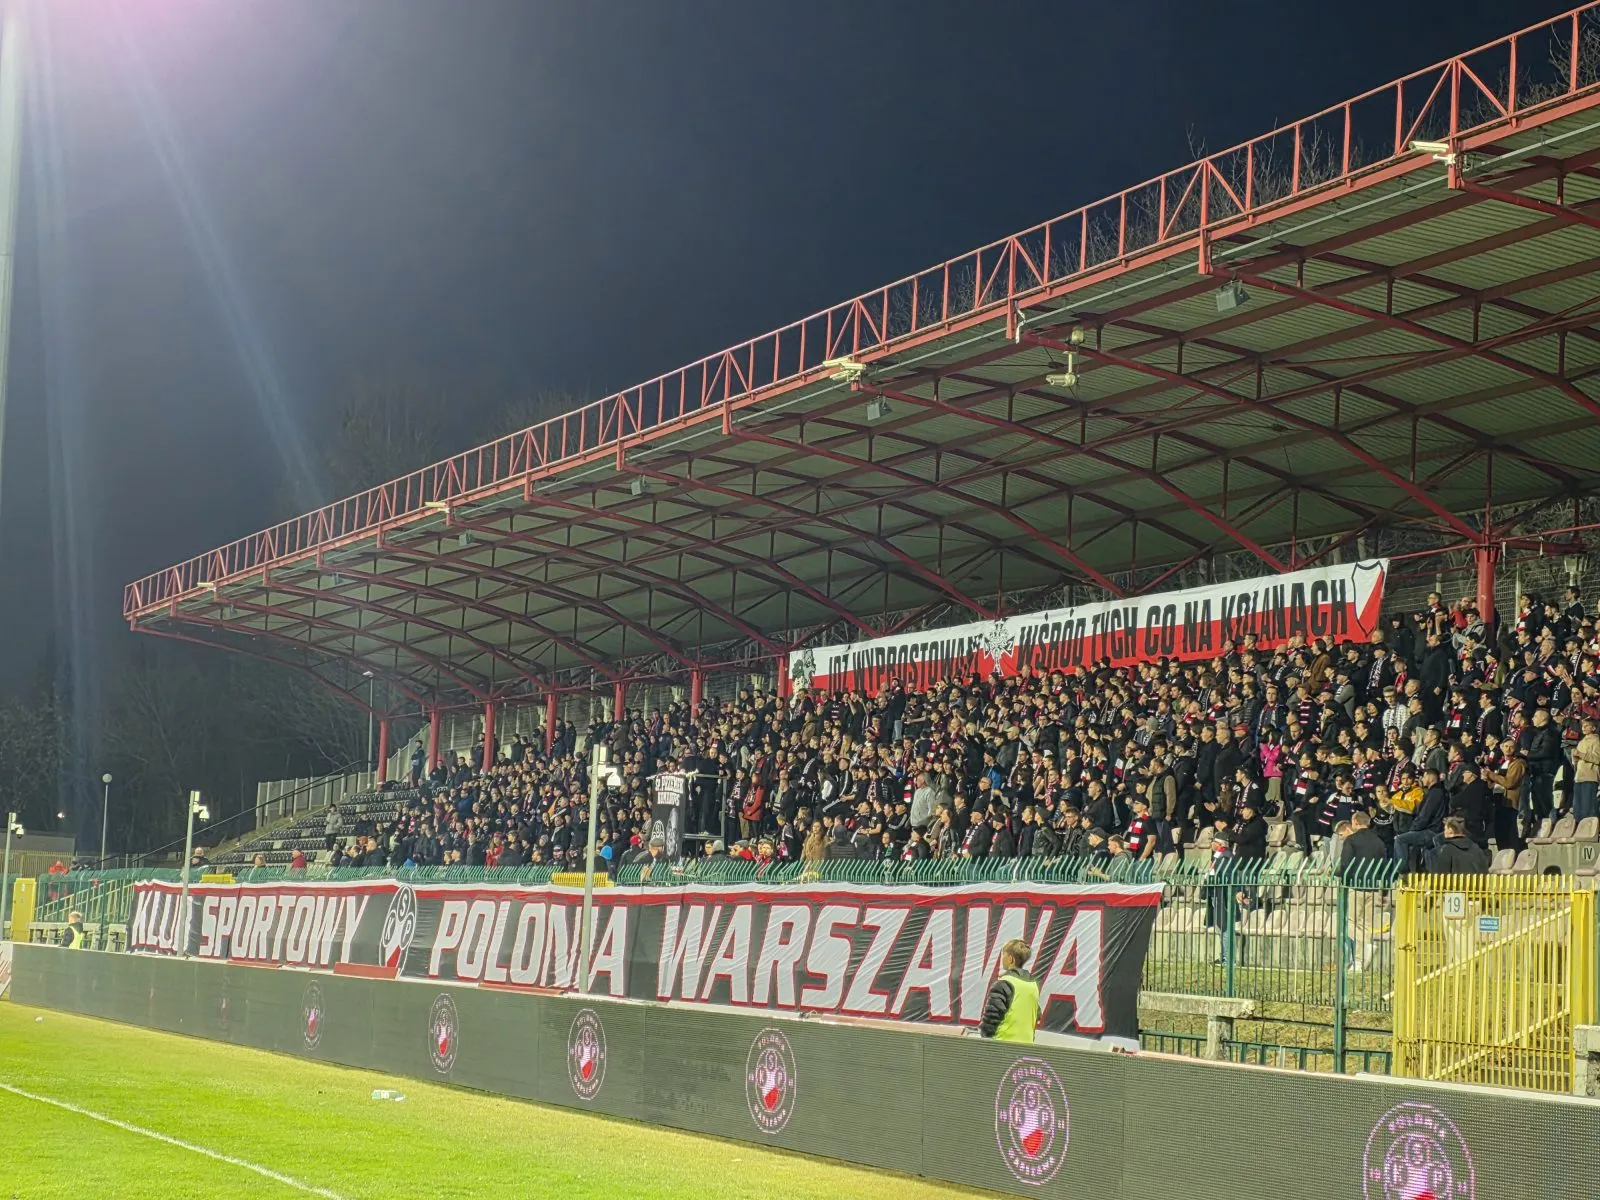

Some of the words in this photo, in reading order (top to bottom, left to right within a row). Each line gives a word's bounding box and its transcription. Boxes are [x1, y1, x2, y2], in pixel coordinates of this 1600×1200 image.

[1016, 607, 1086, 671] WŚRÓD
[1091, 606, 1138, 663] TYCH
[1145, 604, 1177, 657] CO
[1183, 598, 1213, 653] NA
[198, 894, 370, 966] SPORTOWY
[1447, 896, 1461, 913] 19
[657, 902, 1104, 1031] WARSZAWA
